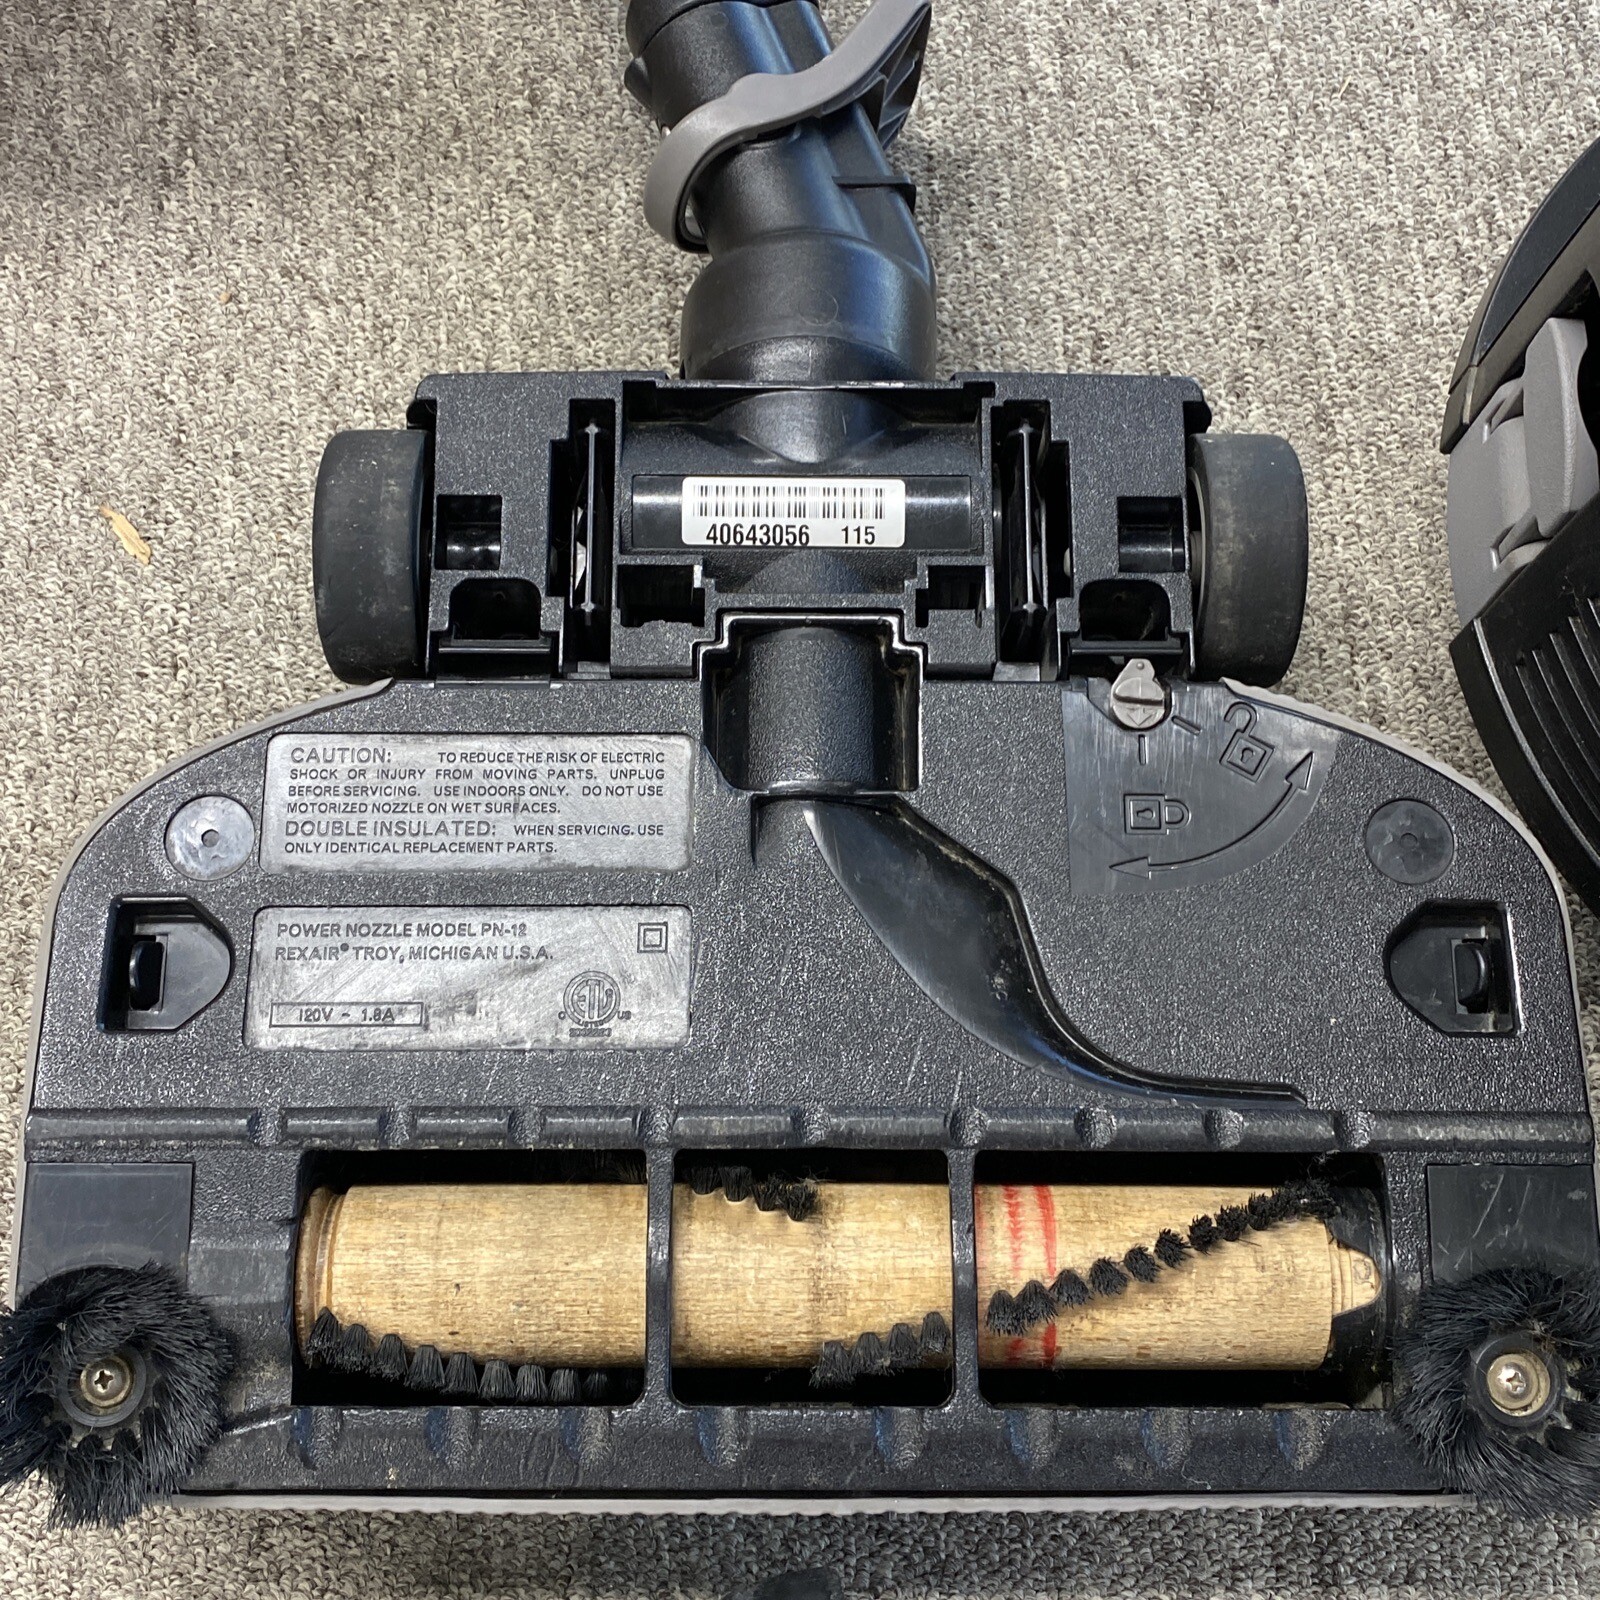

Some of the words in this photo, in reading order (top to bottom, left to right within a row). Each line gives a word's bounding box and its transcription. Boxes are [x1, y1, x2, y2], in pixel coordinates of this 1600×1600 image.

[706, 523, 810, 546] 40643056
[841, 526, 876, 545] 115
[290, 747, 391, 764] CAUTION:
[438, 752, 457, 763] TO
[460, 752, 514, 763] REDUCE
[518, 752, 542, 763] THE
[546, 752, 577, 763] RISK
[580, 752, 598, 763] OF
[601, 752, 665, 763] ELECTRIC
[290, 768, 338, 780] SHOCK
[347, 768, 367, 780] OR
[376, 768, 426, 780] INJURY
[435, 768, 473, 780] FROM
[483, 768, 537, 780] MOVING
[547, 768, 597, 780] PARTS.
[610, 768, 665, 780] UNPLUG
[288, 785, 340, 797] BEFORE
[343, 785, 421, 797] SERVICING.
[433, 785, 460, 797] USE
[463, 785, 526, 797] INDOORS
[529, 785, 569, 797] ONLY.
[582, 785, 602, 797] DO
[605, 785, 634, 797] NOT
[637, 785, 664, 797] USE
[287, 802, 368, 814] MOTORIZED
[371, 802, 424, 814] NOZZLE
[427, 802, 447, 814] ON
[451, 802, 481, 814] WET
[484, 802, 561, 814] SURFACES.
[285, 820, 368, 837] DOUBLE
[373, 820, 497, 837] INSULATED:
[514, 824, 554, 836] WHEN
[637, 824, 664, 836] USE
[284, 842, 322, 854] ONLY
[325, 842, 400, 854] IDENTICAL
[403, 842, 504, 854] REPLACEMENT
[506, 842, 557, 854] PARTS.
[277, 923, 341, 938] POWER
[345, 923, 413, 938] NOZZLE
[416, 923, 476, 938] MODEL
[481, 923, 528, 937] PN-12
[352, 945, 405, 964] TROY,
[408, 945, 498, 961] MICHIGAN
[503, 945, 554, 961] U.S.A.
[299, 1007, 333, 1023] 120V
[361, 1007, 395, 1023] 1.8A
